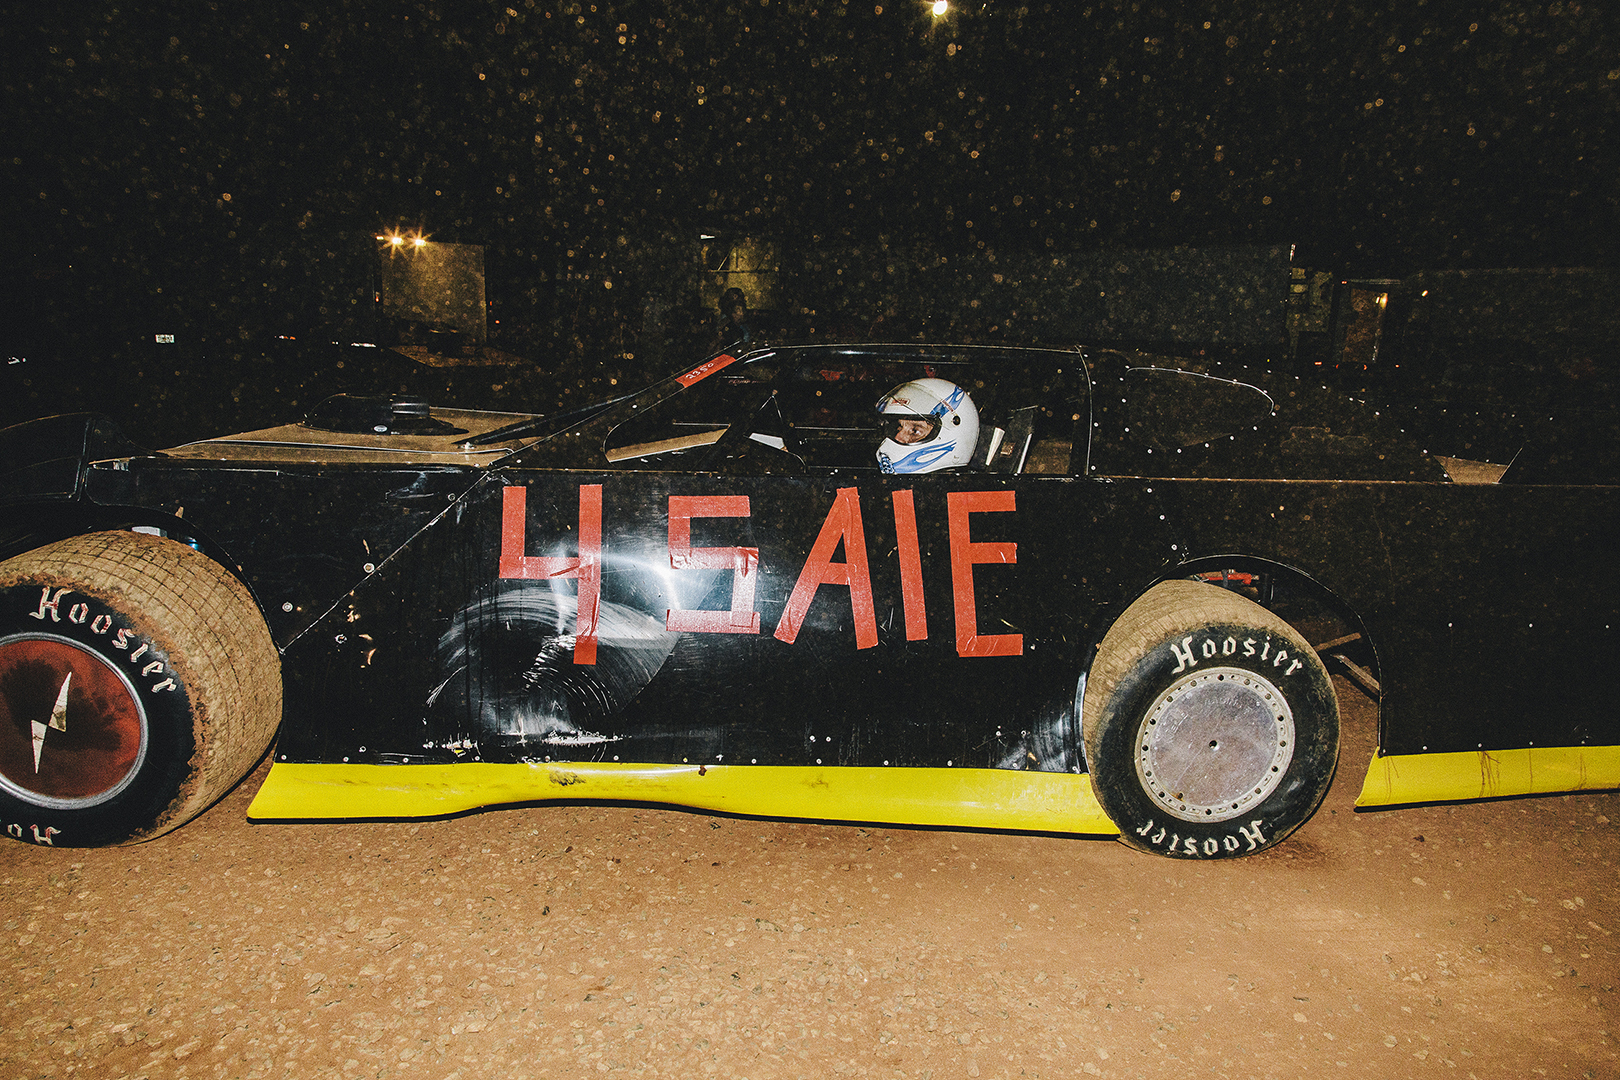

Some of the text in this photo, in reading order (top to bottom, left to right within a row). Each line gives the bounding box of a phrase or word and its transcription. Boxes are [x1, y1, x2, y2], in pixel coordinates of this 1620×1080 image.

[499, 484, 603, 665] 4
[29, 586, 177, 693] Hoosier
[1170, 635, 1303, 676] Hoosier
[0, 821, 62, 846] Ho
[1136, 819, 1267, 856] Hoosier
